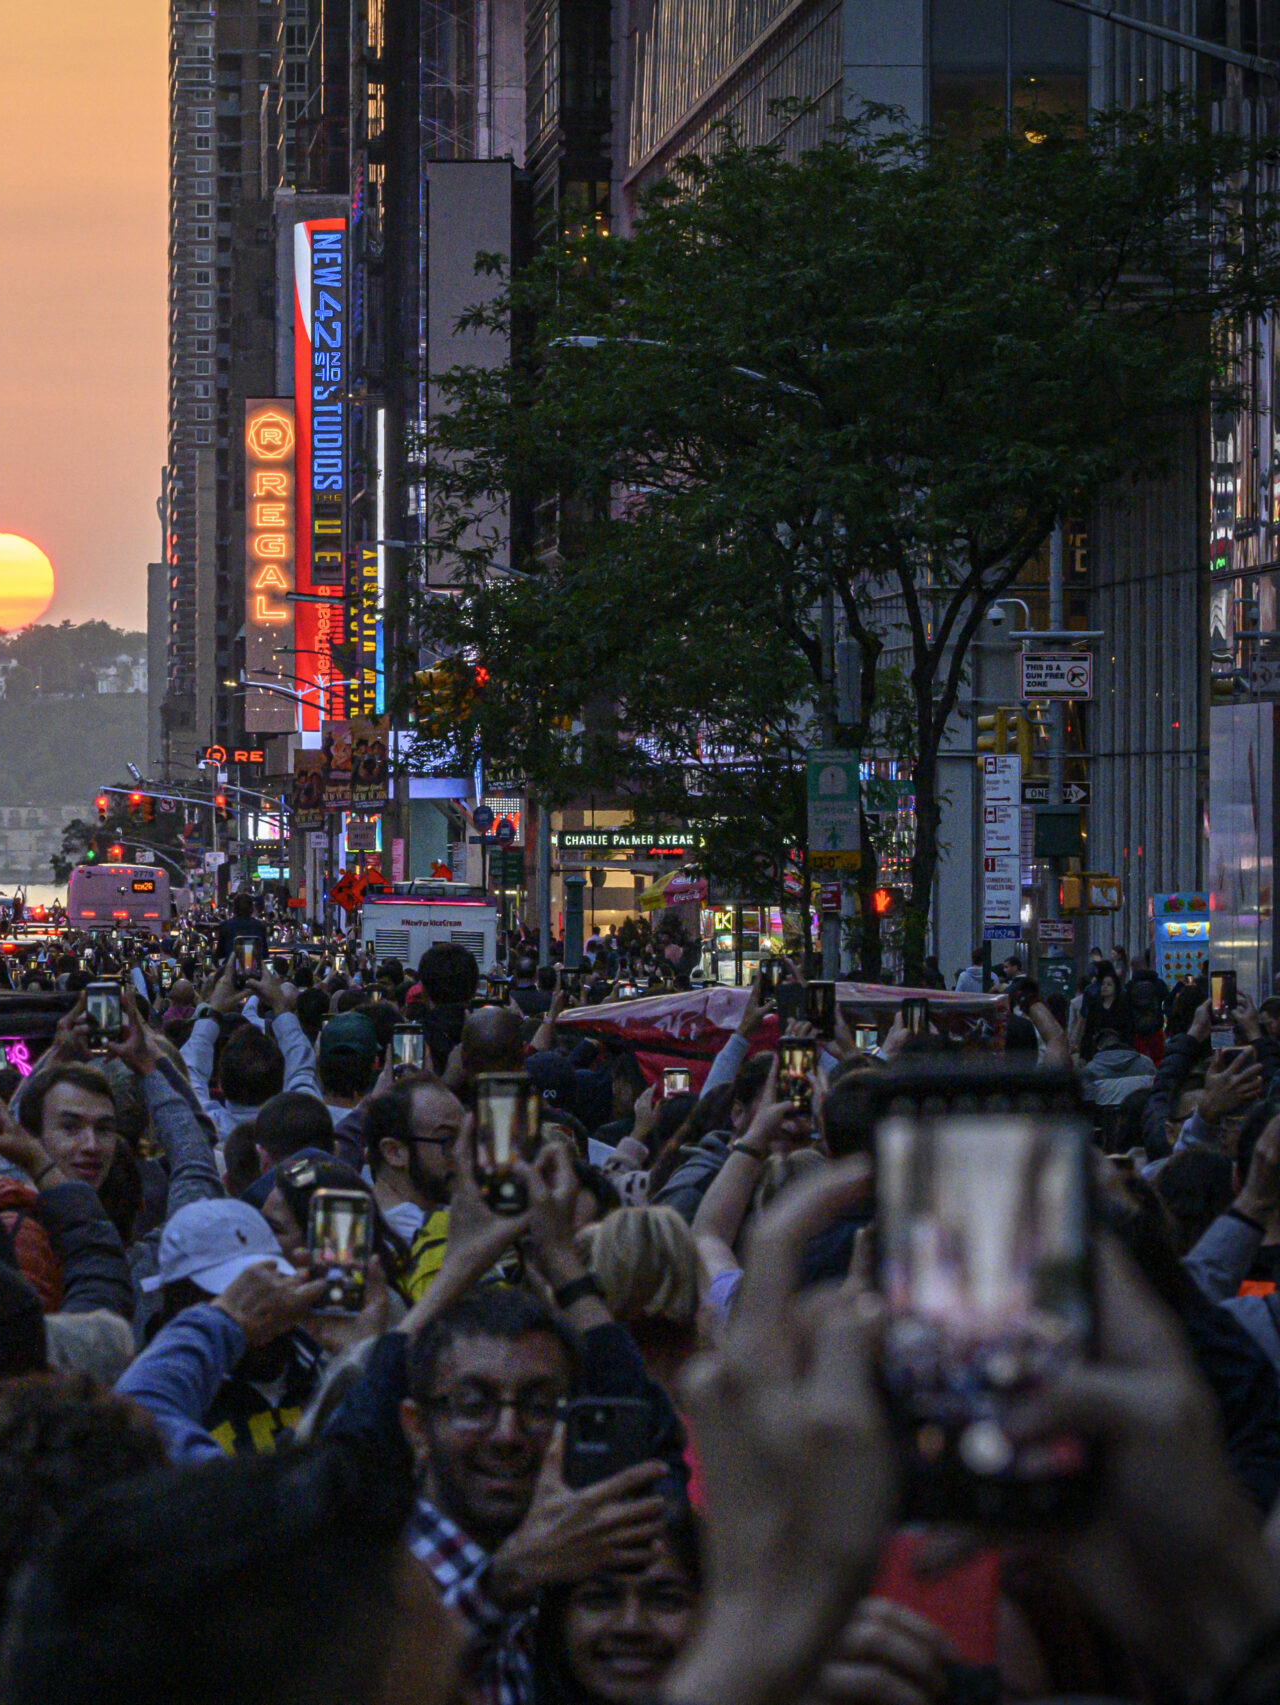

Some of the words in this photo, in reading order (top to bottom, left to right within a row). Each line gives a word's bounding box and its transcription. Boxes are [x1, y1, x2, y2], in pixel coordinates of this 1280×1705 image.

[254, 472, 287, 619] REGAL
[314, 585, 331, 652] Theate
[565, 835, 608, 845] CHARLIE
[613, 835, 654, 846] PALMER
[658, 835, 694, 845] STEAK
